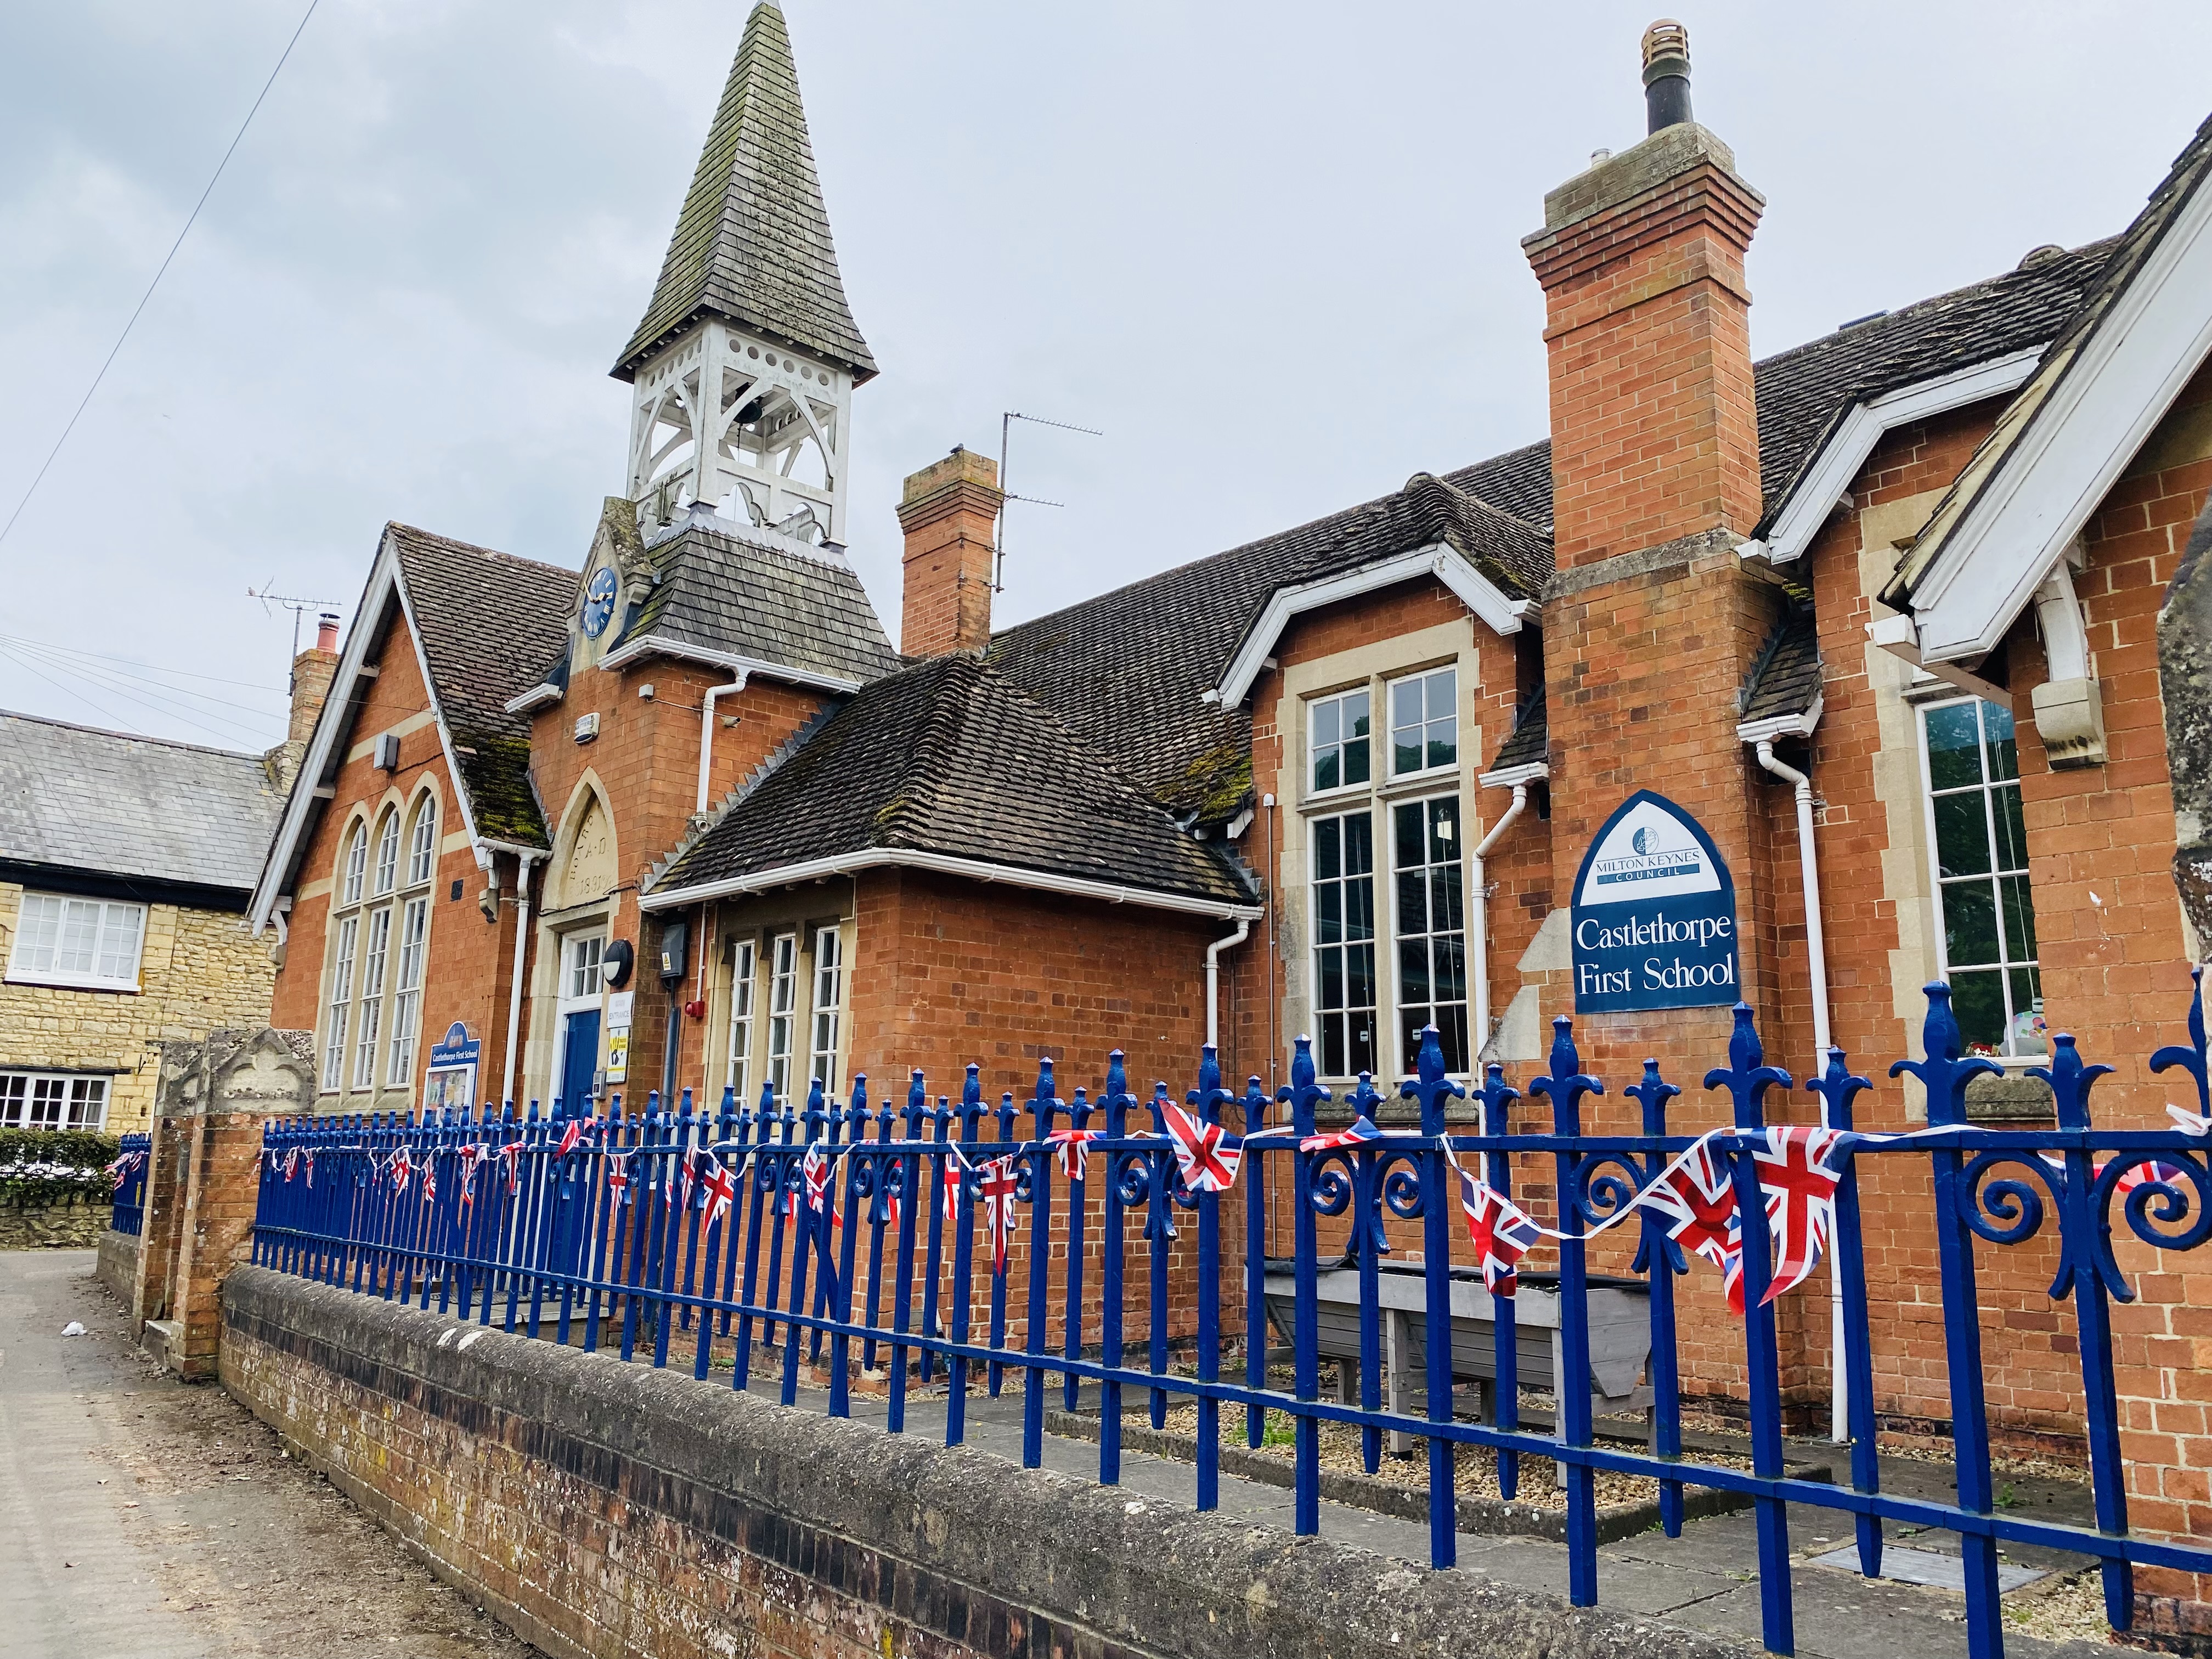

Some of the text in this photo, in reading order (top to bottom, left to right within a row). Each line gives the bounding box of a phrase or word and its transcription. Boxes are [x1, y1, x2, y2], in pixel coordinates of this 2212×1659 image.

[1596, 851, 1700, 873] MILTON KEYNES
[1616, 867, 1680, 882] COUNCIL
[1576, 911, 1732, 950] Castlethorpe
[1578, 952, 1736, 995] First School
[609, 1010, 629, 1020] ENTRANCE
[432, 1048, 478, 1063] Castlethorpe First School
